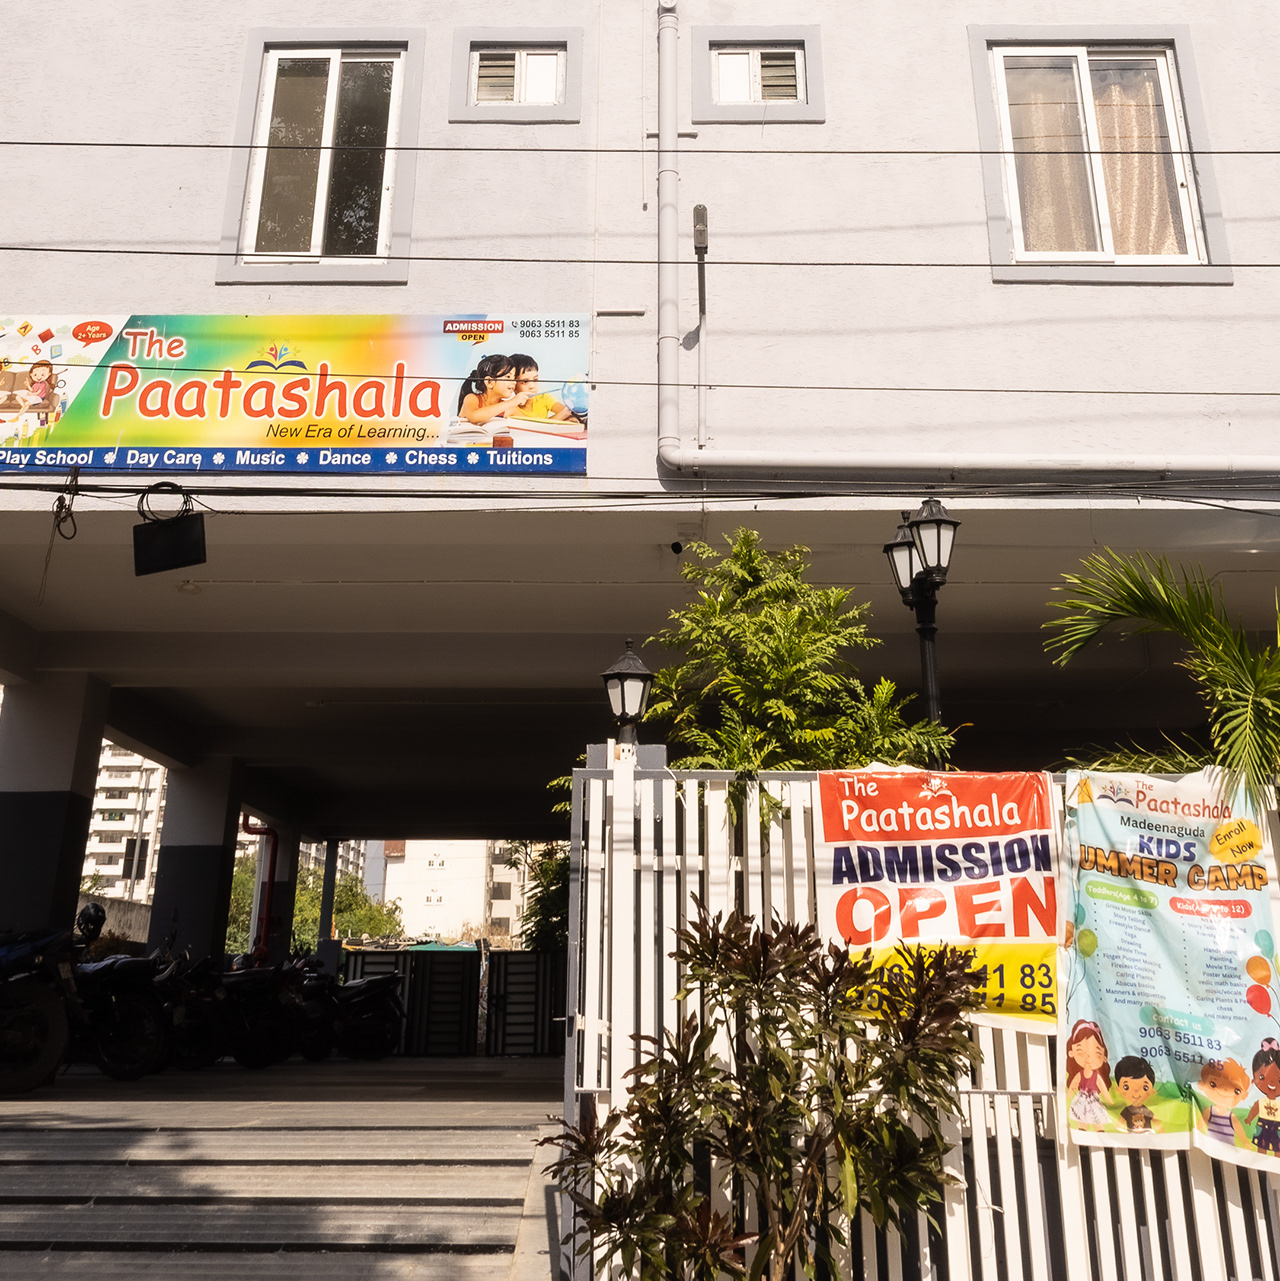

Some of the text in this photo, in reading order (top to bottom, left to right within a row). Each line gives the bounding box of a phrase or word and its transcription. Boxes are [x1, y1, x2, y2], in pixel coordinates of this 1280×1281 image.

[445, 323, 502, 331] ADMISSION
[520, 320, 579, 328] 9063 5511 83
[520, 330, 579, 338] 9063 5511 85
[125, 329, 185, 359] The
[102, 363, 442, 418] Paatashala
[266, 424, 440, 441] New Era of Learning...
[34, 450, 93, 465] School
[126, 450, 160, 468] Day
[163, 450, 202, 465] Care
[235, 450, 286, 465] Music
[318, 450, 371, 465] Dance
[404, 450, 457, 465] Chess
[486, 450, 553, 465] Tuitions
[839, 776, 879, 797] The
[1135, 780, 1154, 792] The
[841, 793, 1022, 832] Paatashala
[1134, 790, 1232, 819] Paatashala
[1120, 815, 1205, 838] Madeenaguda
[1215, 821, 1247, 846] Enroll
[1138, 834, 1197, 862] KIDS
[1229, 840, 1255, 859] Now
[832, 834, 1052, 885] ADMISSION
[1079, 844, 1268, 892] UMMER CAMP
[835, 876, 1057, 946] OPEN
[1138, 909, 1152, 917] Skills
[1231, 905, 1245, 914] 12)
[1103, 953, 1121, 961] Finger
[1019, 963, 1053, 989] 83
[1116, 971, 1135, 979] Caring
[1205, 963, 1222, 971] Movie
[1105, 988, 1131, 996] Manners
[1127, 998, 1143, 1007] many
[1152, 1013, 1202, 1031] contact us
[1139, 1027, 1222, 1051] 9063 5511 83
[1141, 1045, 1224, 1071] 9063 5511 85
